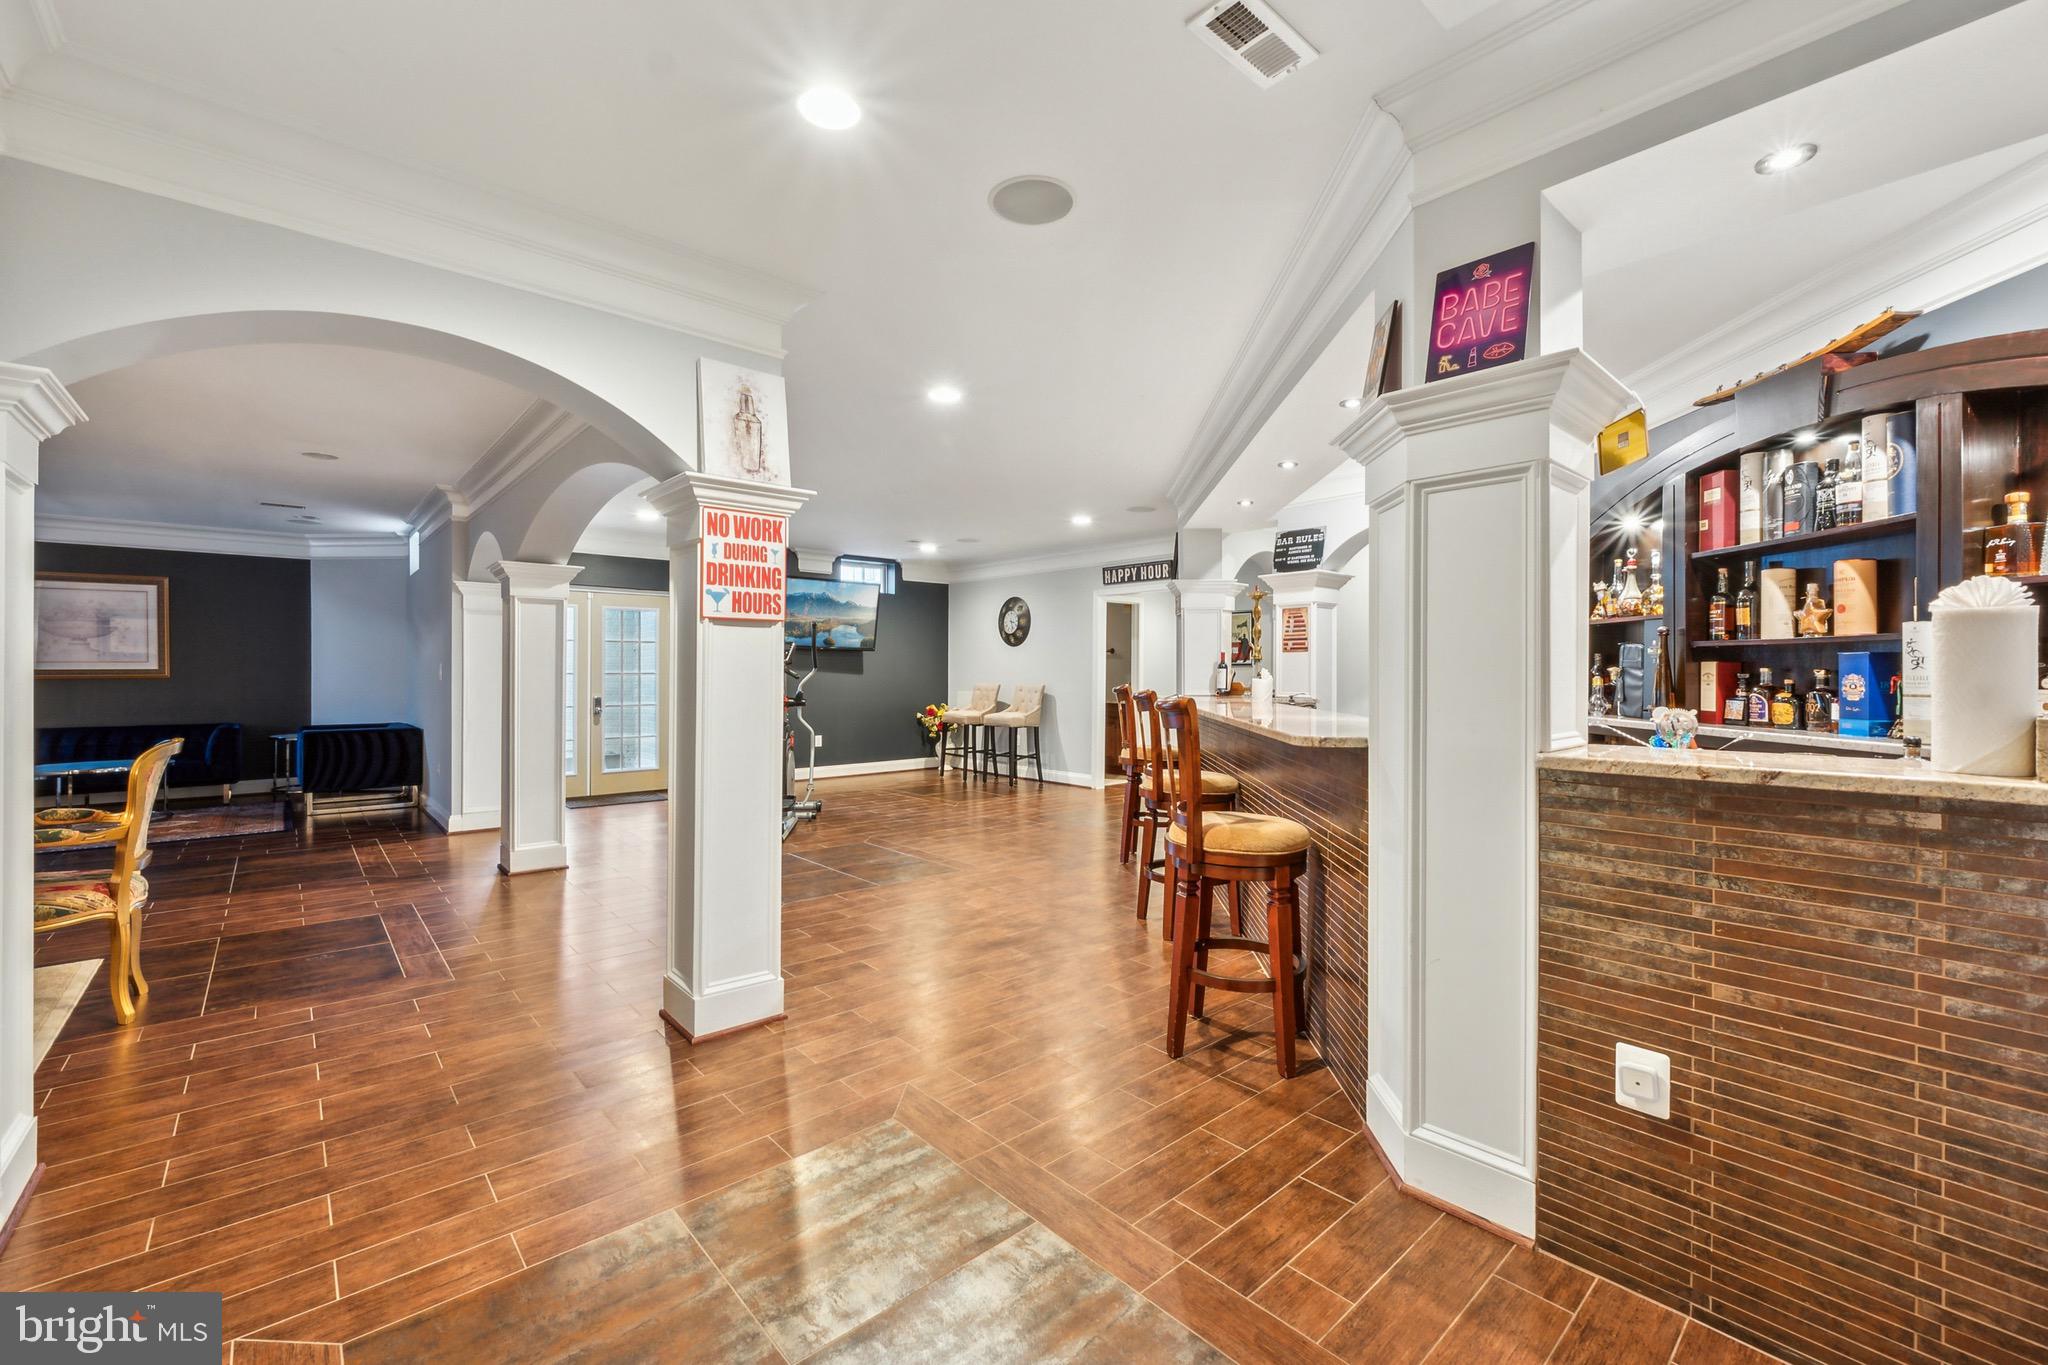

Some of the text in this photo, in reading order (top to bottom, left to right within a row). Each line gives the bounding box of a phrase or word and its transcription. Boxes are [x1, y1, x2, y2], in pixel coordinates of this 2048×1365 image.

[1441, 272, 1523, 321] BABE
[1437, 302, 1519, 349] CAVE
[707, 511, 783, 544] NO WORK
[1276, 533, 1324, 546] BAR RULES
[723, 542, 768, 563] DURING
[706, 561, 782, 590] DRINKING
[1104, 563, 1169, 584] HAPPY HOUR
[731, 590, 782, 616] HOURS
